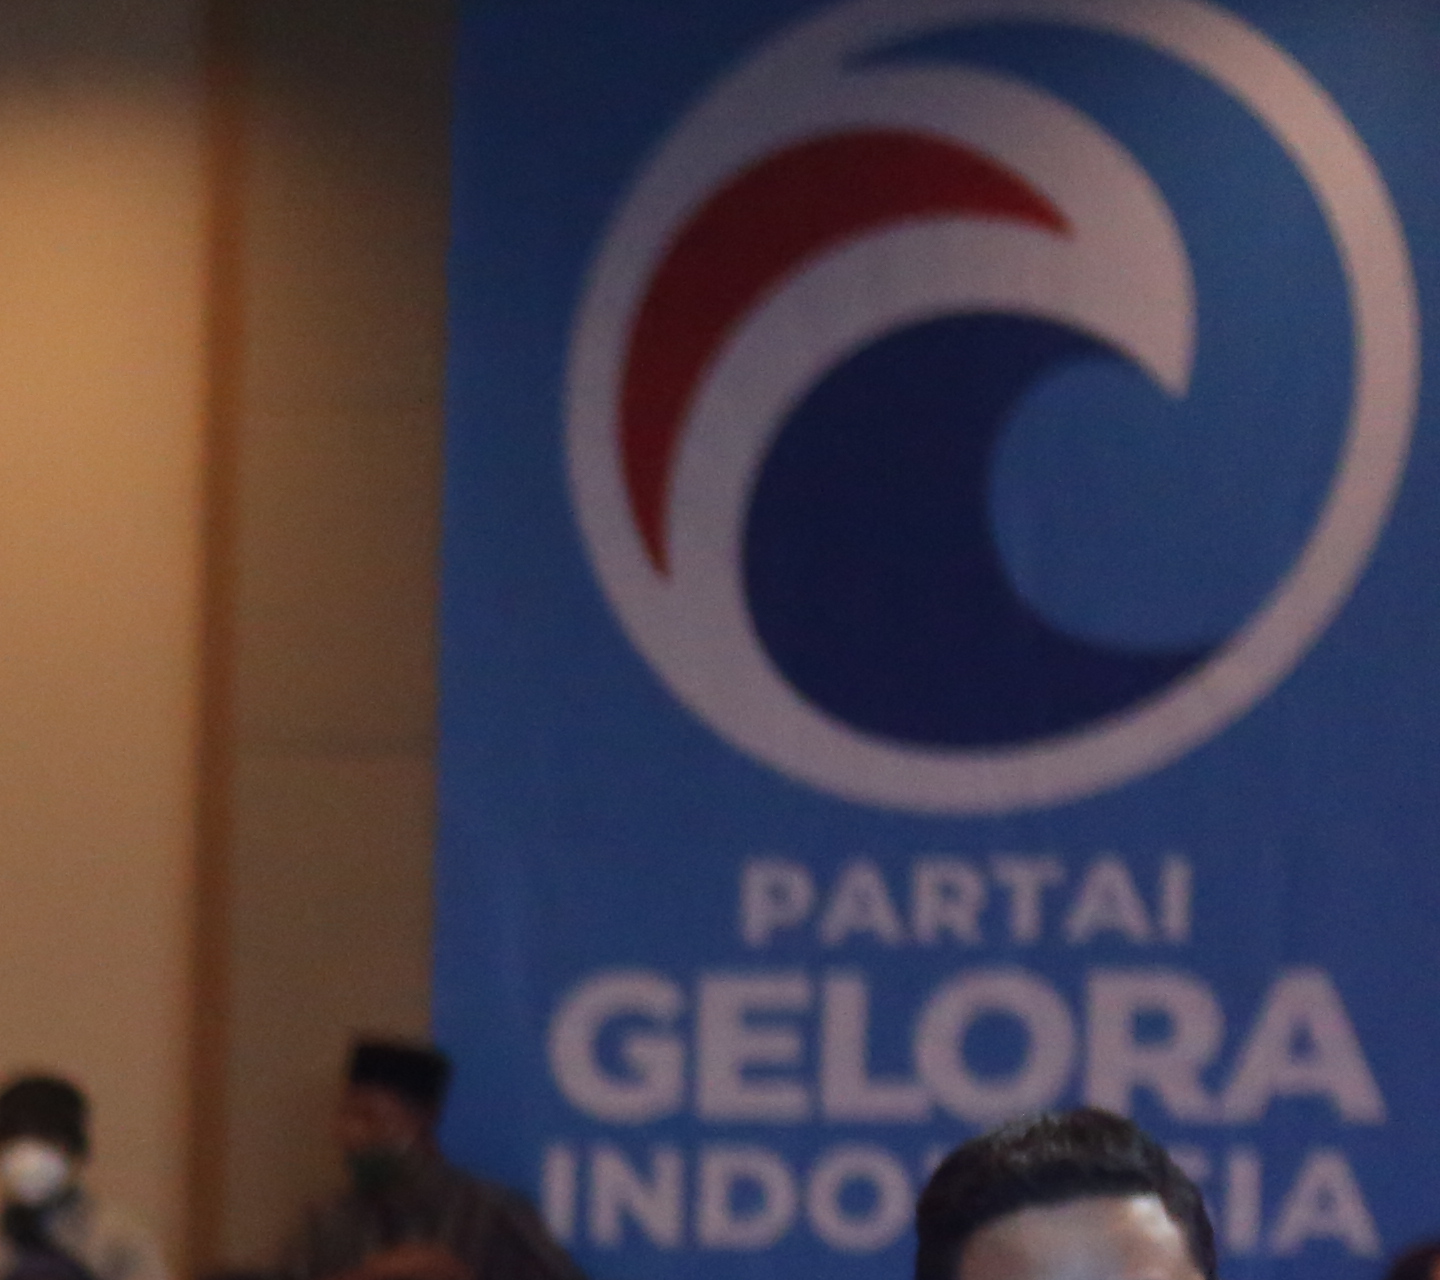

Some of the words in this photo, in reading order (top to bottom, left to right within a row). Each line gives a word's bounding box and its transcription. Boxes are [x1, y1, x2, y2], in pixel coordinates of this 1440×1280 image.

[738, 854, 1195, 947] PARTAI
[547, 963, 1388, 1127] GELORA
[542, 1141, 1384, 1259] INDOIA
